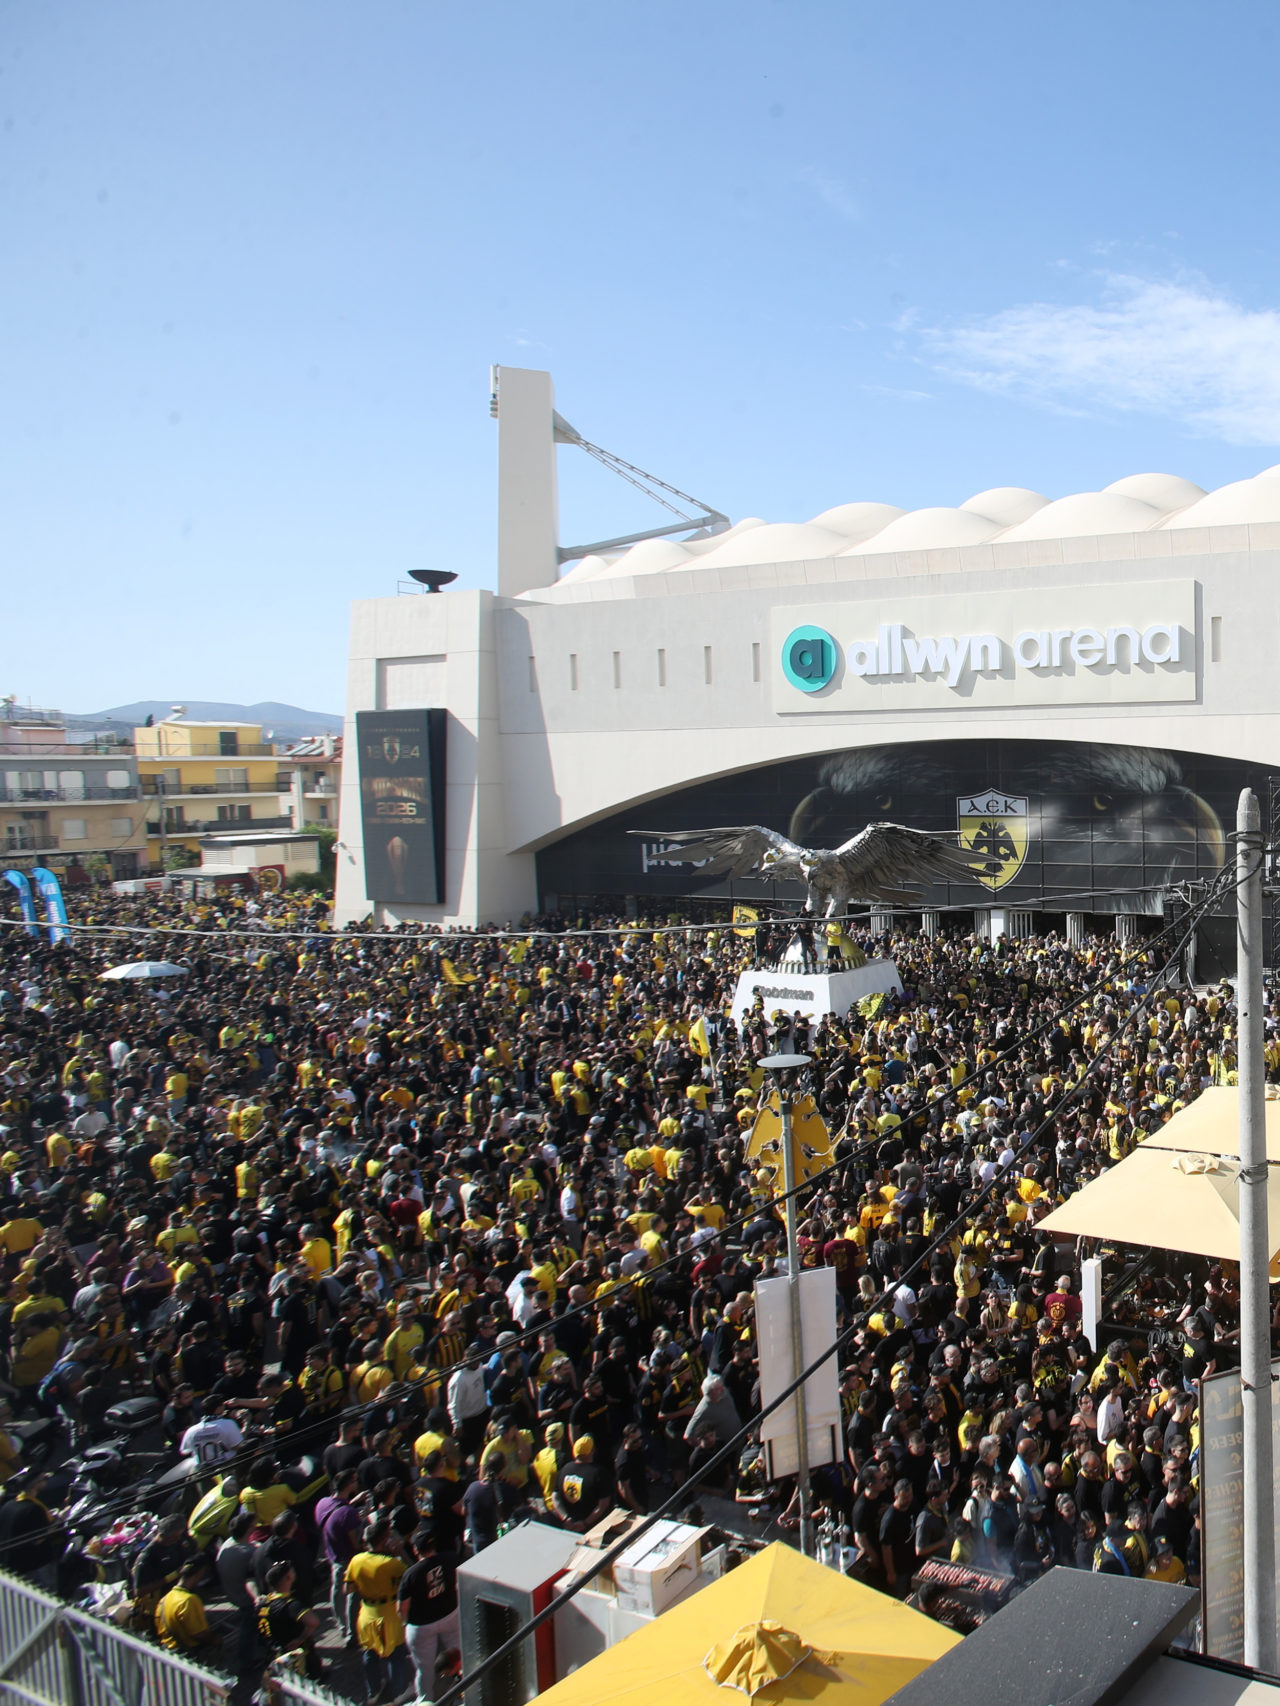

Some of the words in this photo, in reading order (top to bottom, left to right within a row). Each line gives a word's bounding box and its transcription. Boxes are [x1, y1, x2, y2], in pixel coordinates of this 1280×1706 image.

[847, 624, 1003, 688] allwyn
[1013, 624, 1182, 669] arena
[376, 802, 417, 815] 2026
